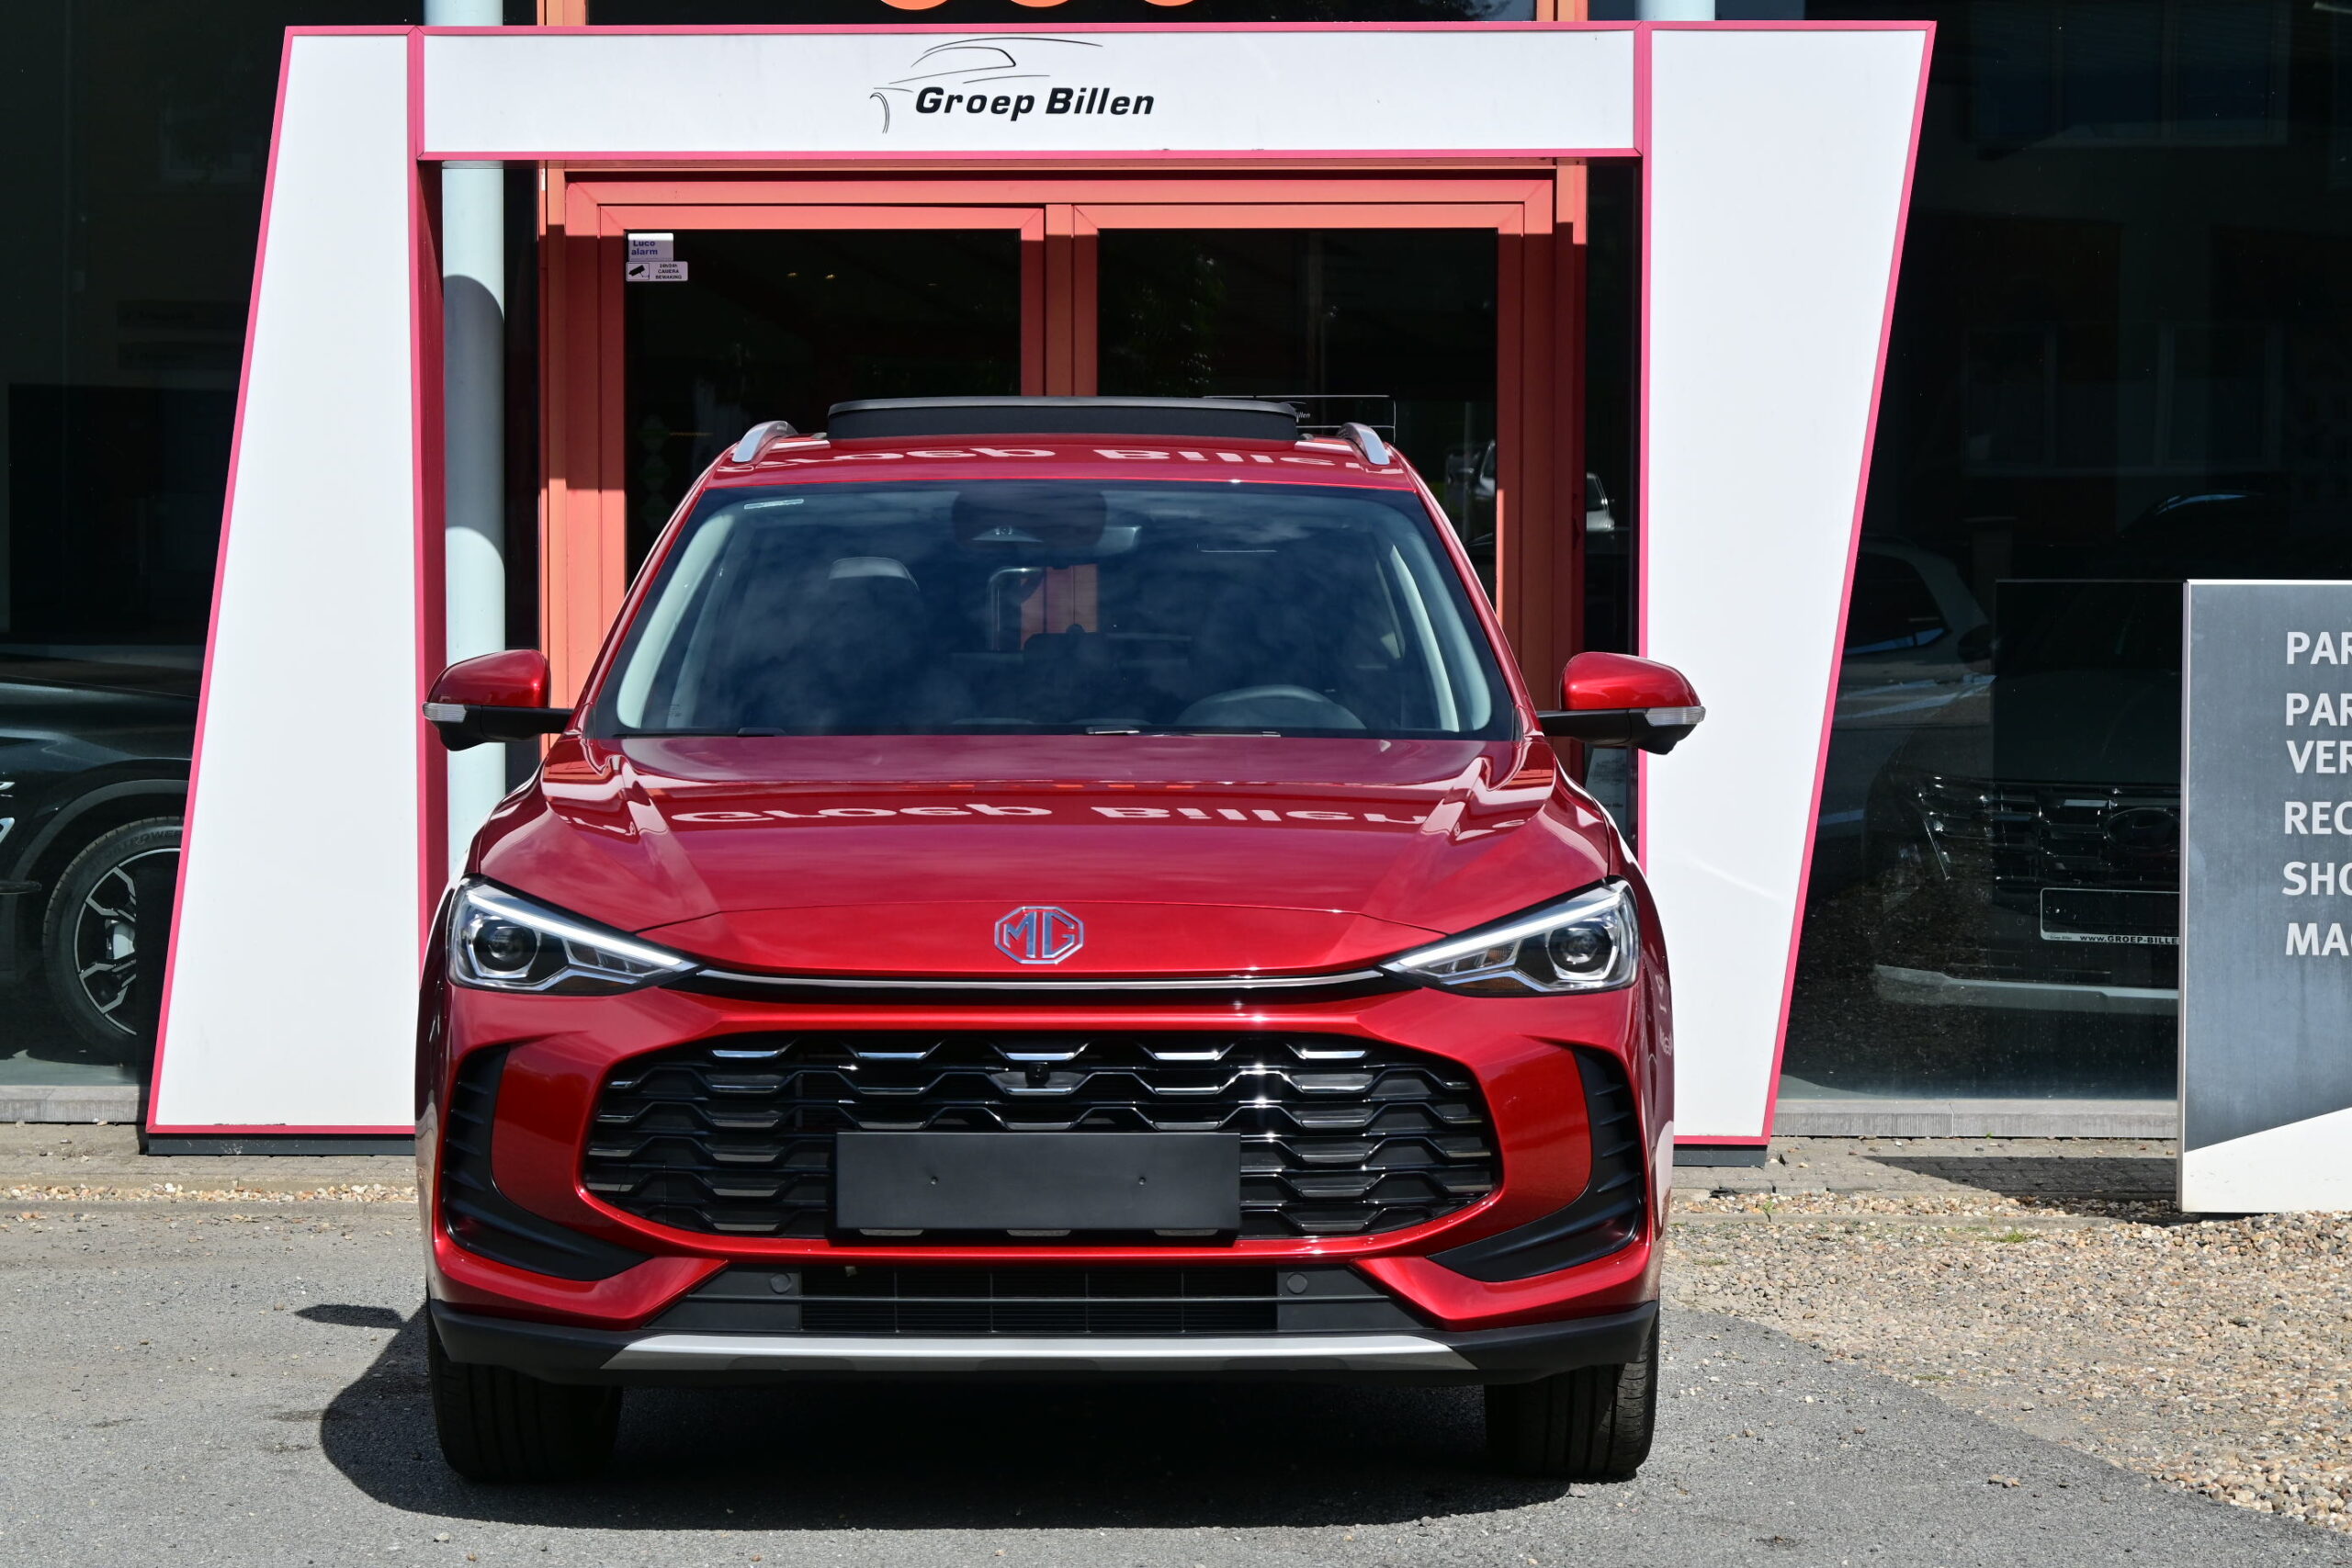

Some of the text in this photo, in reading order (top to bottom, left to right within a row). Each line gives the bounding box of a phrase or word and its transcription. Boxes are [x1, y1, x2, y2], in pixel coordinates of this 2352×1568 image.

[915, 86, 1155, 121] Groep Billen
[1001, 909, 1076, 959] MG
[2285, 922, 2352, 956] MA
